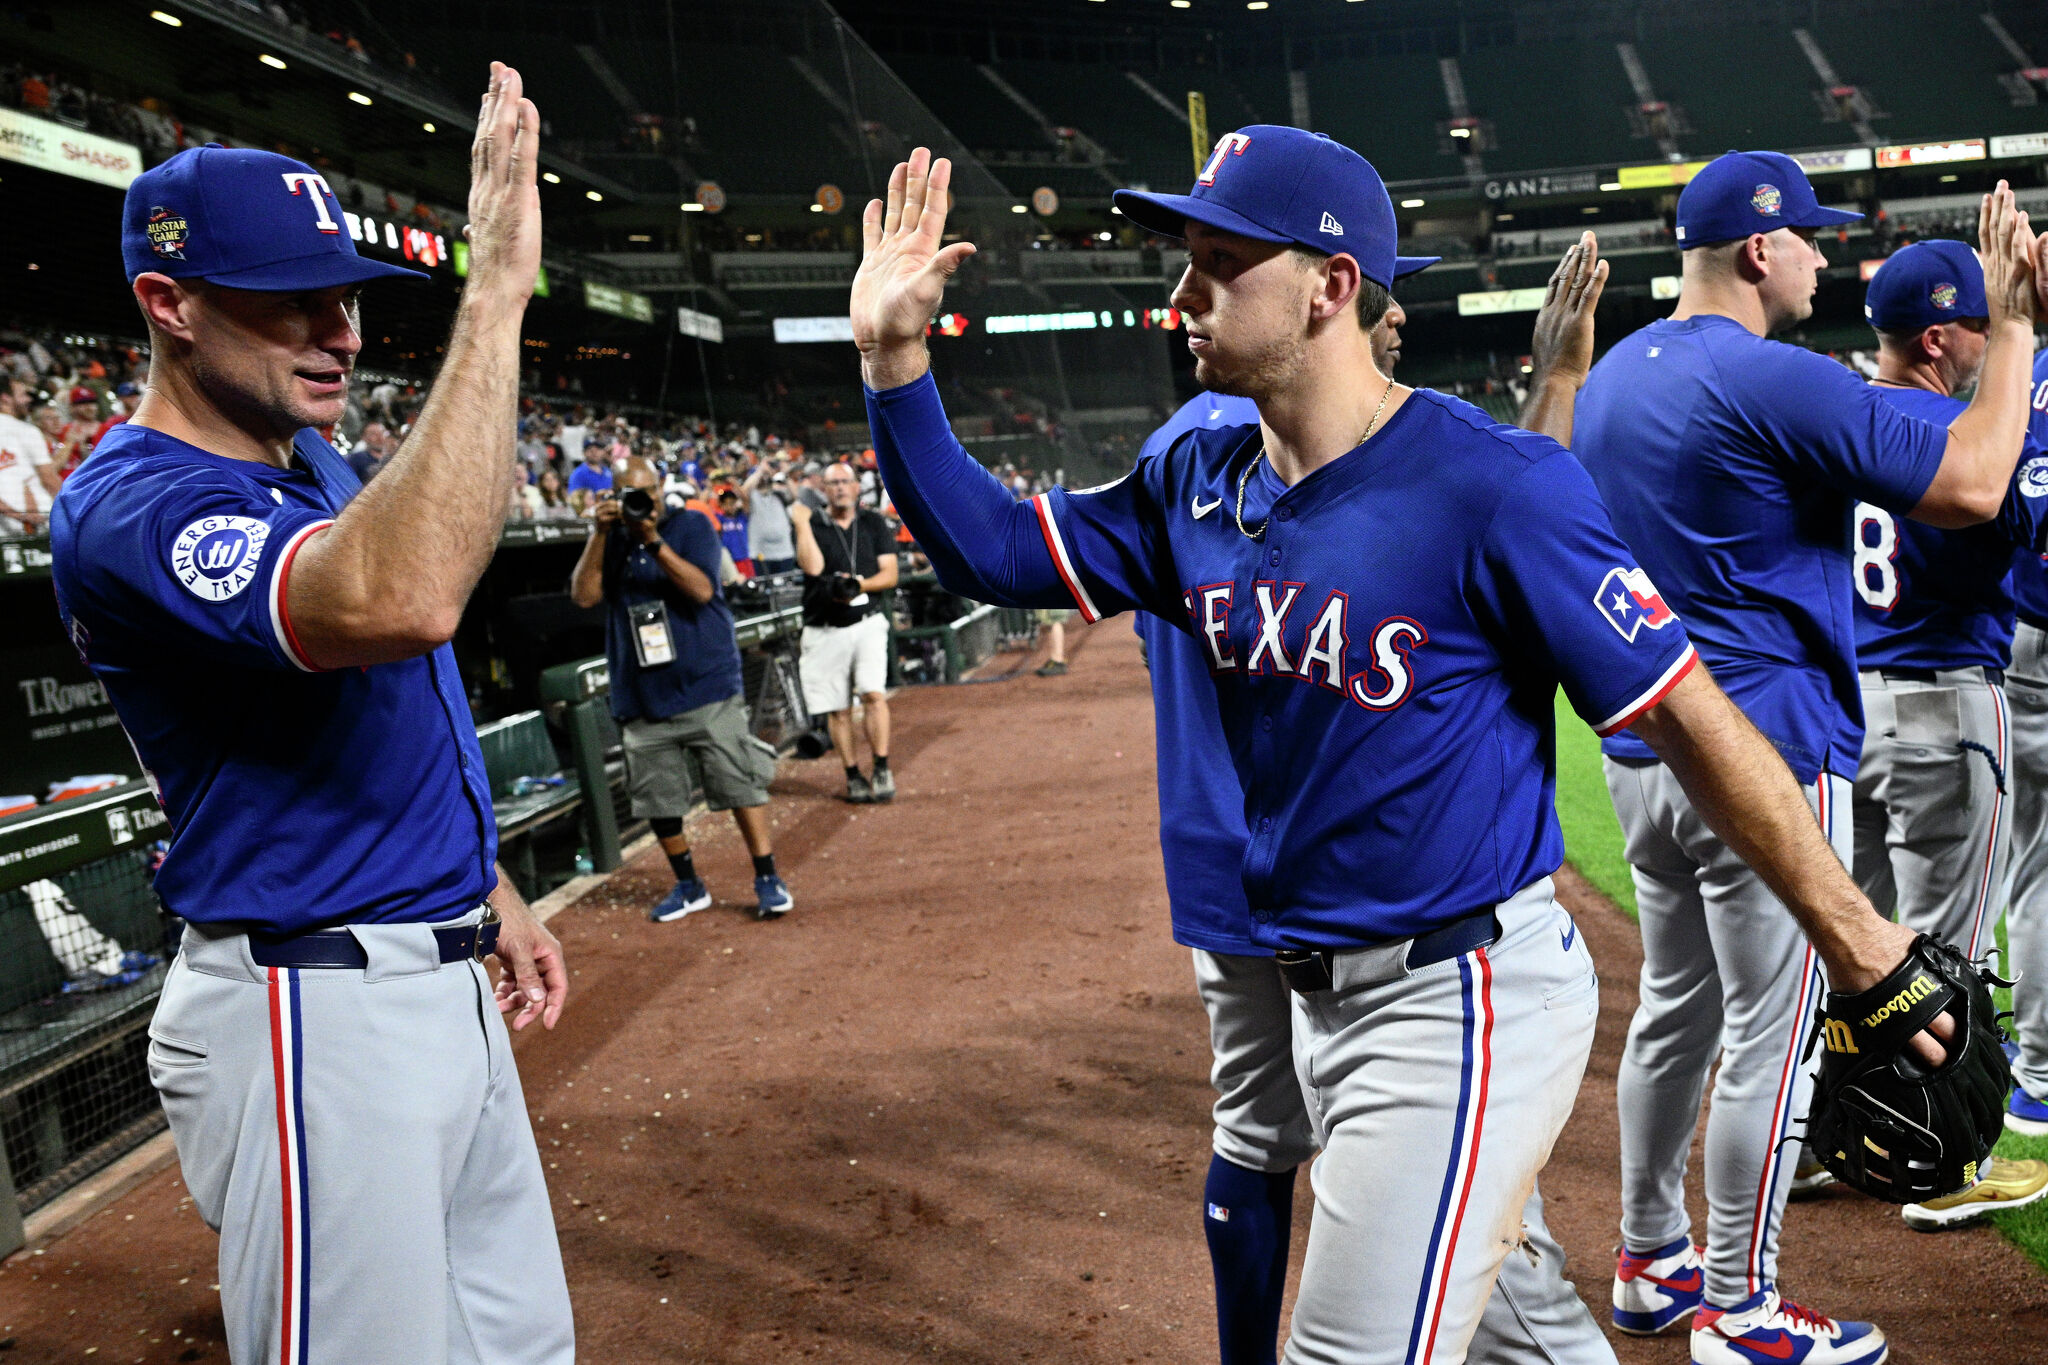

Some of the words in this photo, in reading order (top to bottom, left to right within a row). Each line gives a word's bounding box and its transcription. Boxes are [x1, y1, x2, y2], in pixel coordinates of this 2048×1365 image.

[1199, 132, 1252, 188] T
[281, 172, 341, 235] T
[153, 230, 181, 243] GAME
[175, 517, 236, 586] ENERGY
[211, 521, 267, 599] TRANSFER
[1183, 579, 1429, 712] EXAS
[1863, 975, 1937, 1028] Wilson
